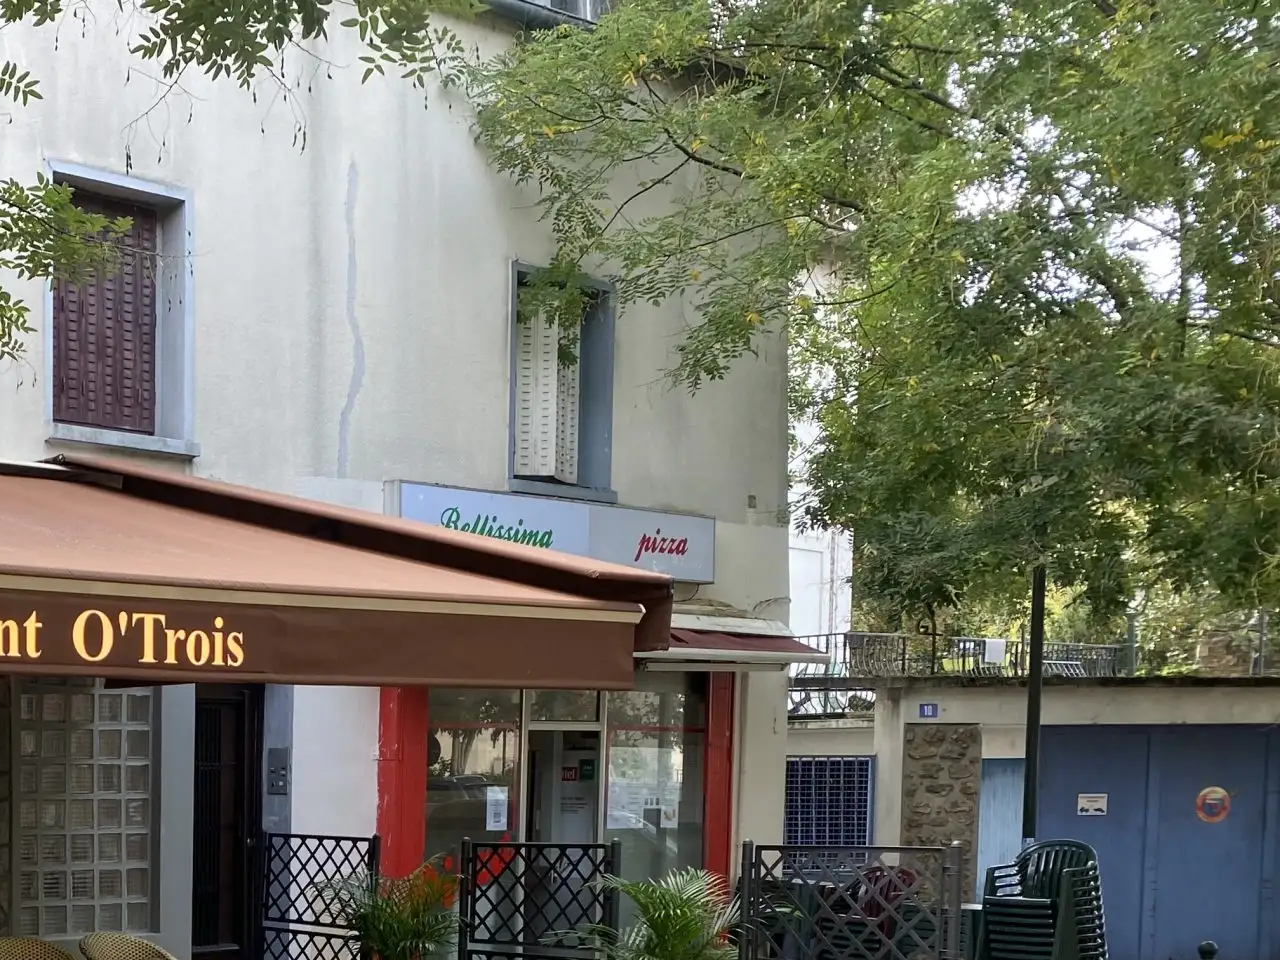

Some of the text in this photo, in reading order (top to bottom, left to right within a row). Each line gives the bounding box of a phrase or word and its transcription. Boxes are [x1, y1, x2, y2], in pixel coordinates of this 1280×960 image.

[440, 506, 553, 548] Bellissima
[634, 528, 688, 562] pizza
[72, 609, 245, 667] O'Trois
[923, 705, 933, 716] 10
